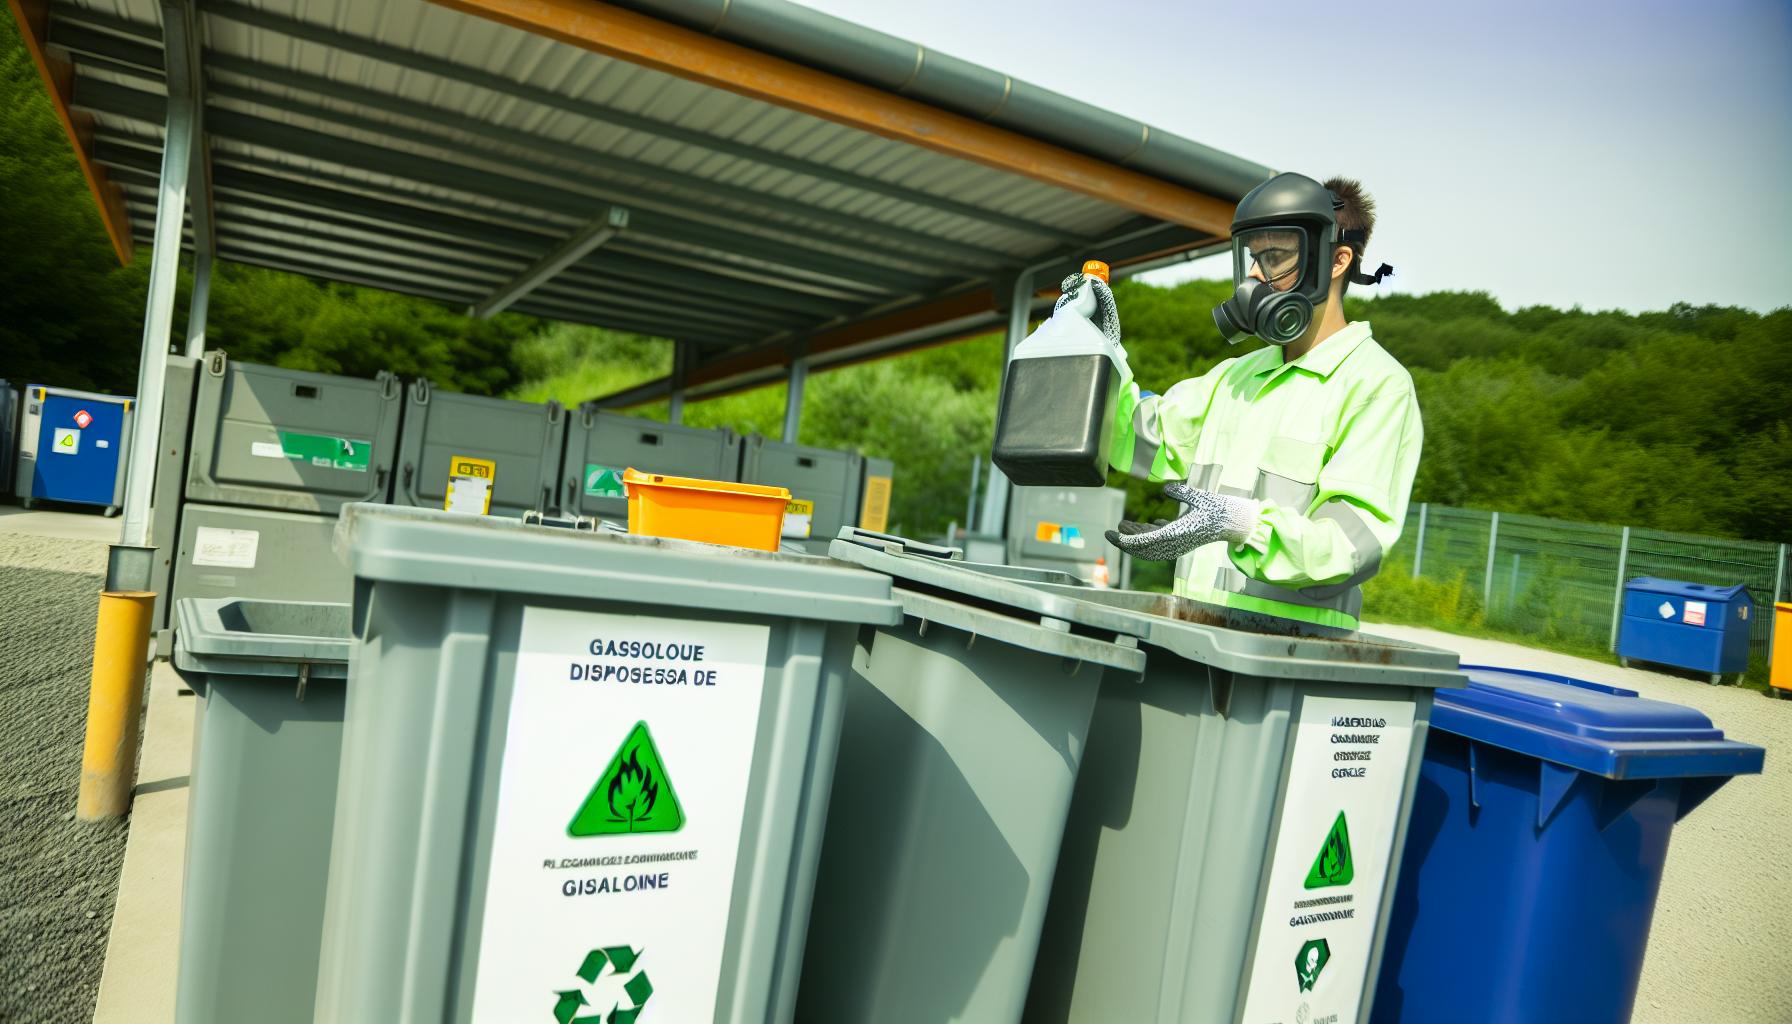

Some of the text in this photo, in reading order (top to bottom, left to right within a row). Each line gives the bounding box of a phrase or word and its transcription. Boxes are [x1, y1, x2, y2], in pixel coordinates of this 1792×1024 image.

[589, 638, 705, 661] GASSOLOUE
[693, 669, 717, 686] DE
[562, 872, 669, 896] GISALOINE
